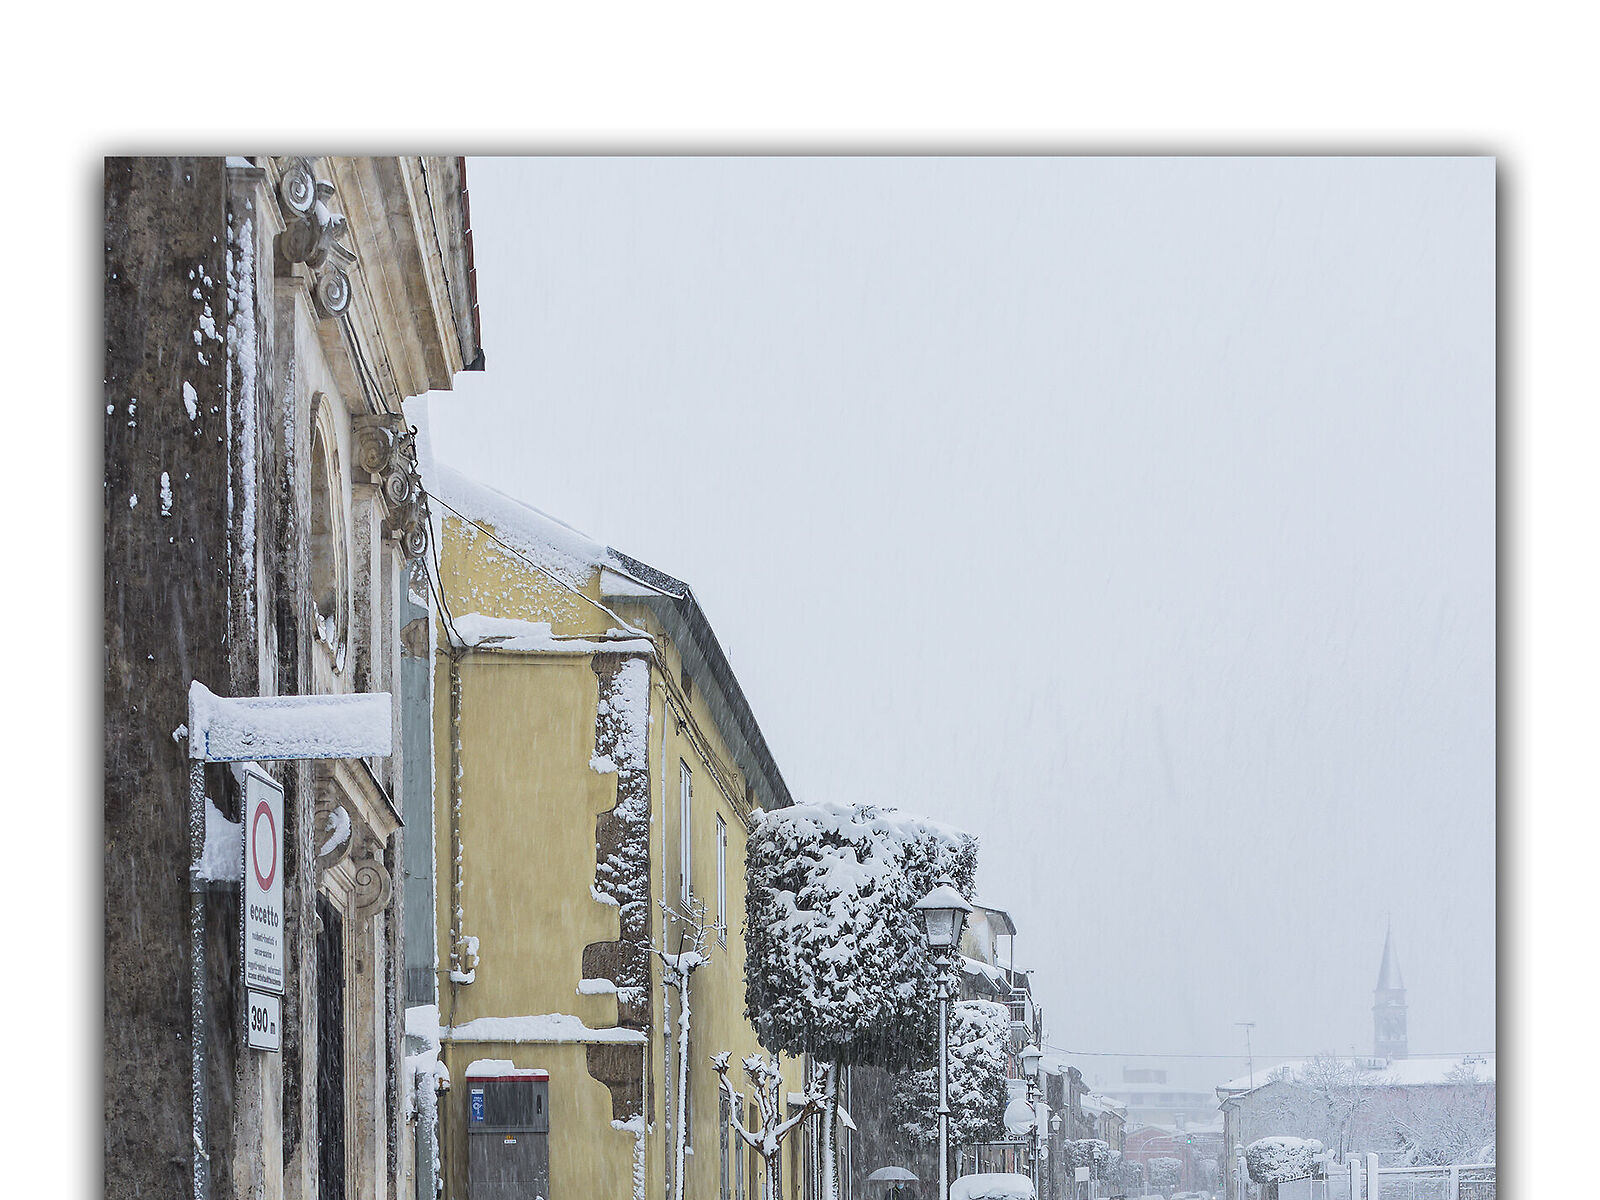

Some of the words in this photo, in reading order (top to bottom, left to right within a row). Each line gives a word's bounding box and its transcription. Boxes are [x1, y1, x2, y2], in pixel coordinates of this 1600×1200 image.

[250, 904, 279, 928] eccetto
[251, 1005, 268, 1033] 390
[270, 1021, 276, 1035] m
